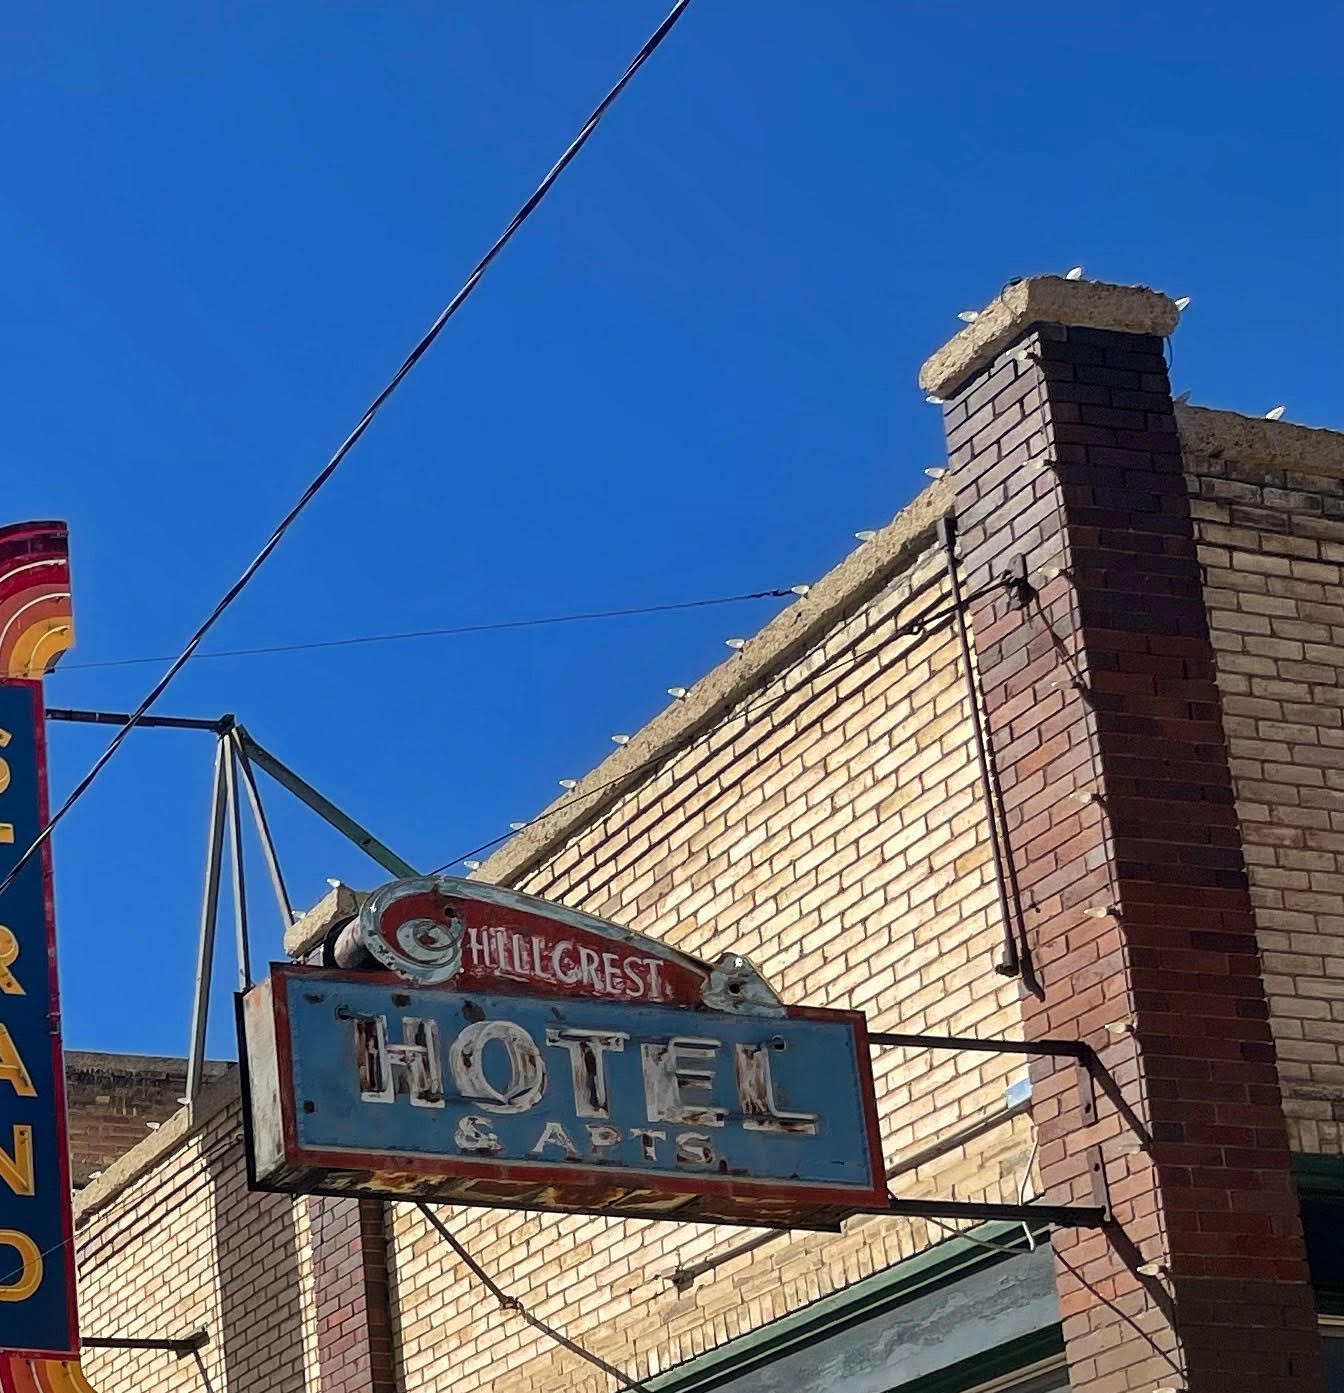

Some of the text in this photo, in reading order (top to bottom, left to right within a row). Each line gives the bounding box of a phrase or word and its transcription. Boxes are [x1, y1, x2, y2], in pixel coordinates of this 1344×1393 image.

[464, 924, 665, 1002] HILLCREST
[353, 1014, 818, 1136] HOTEL
[454, 1114, 714, 1165] & APTS
